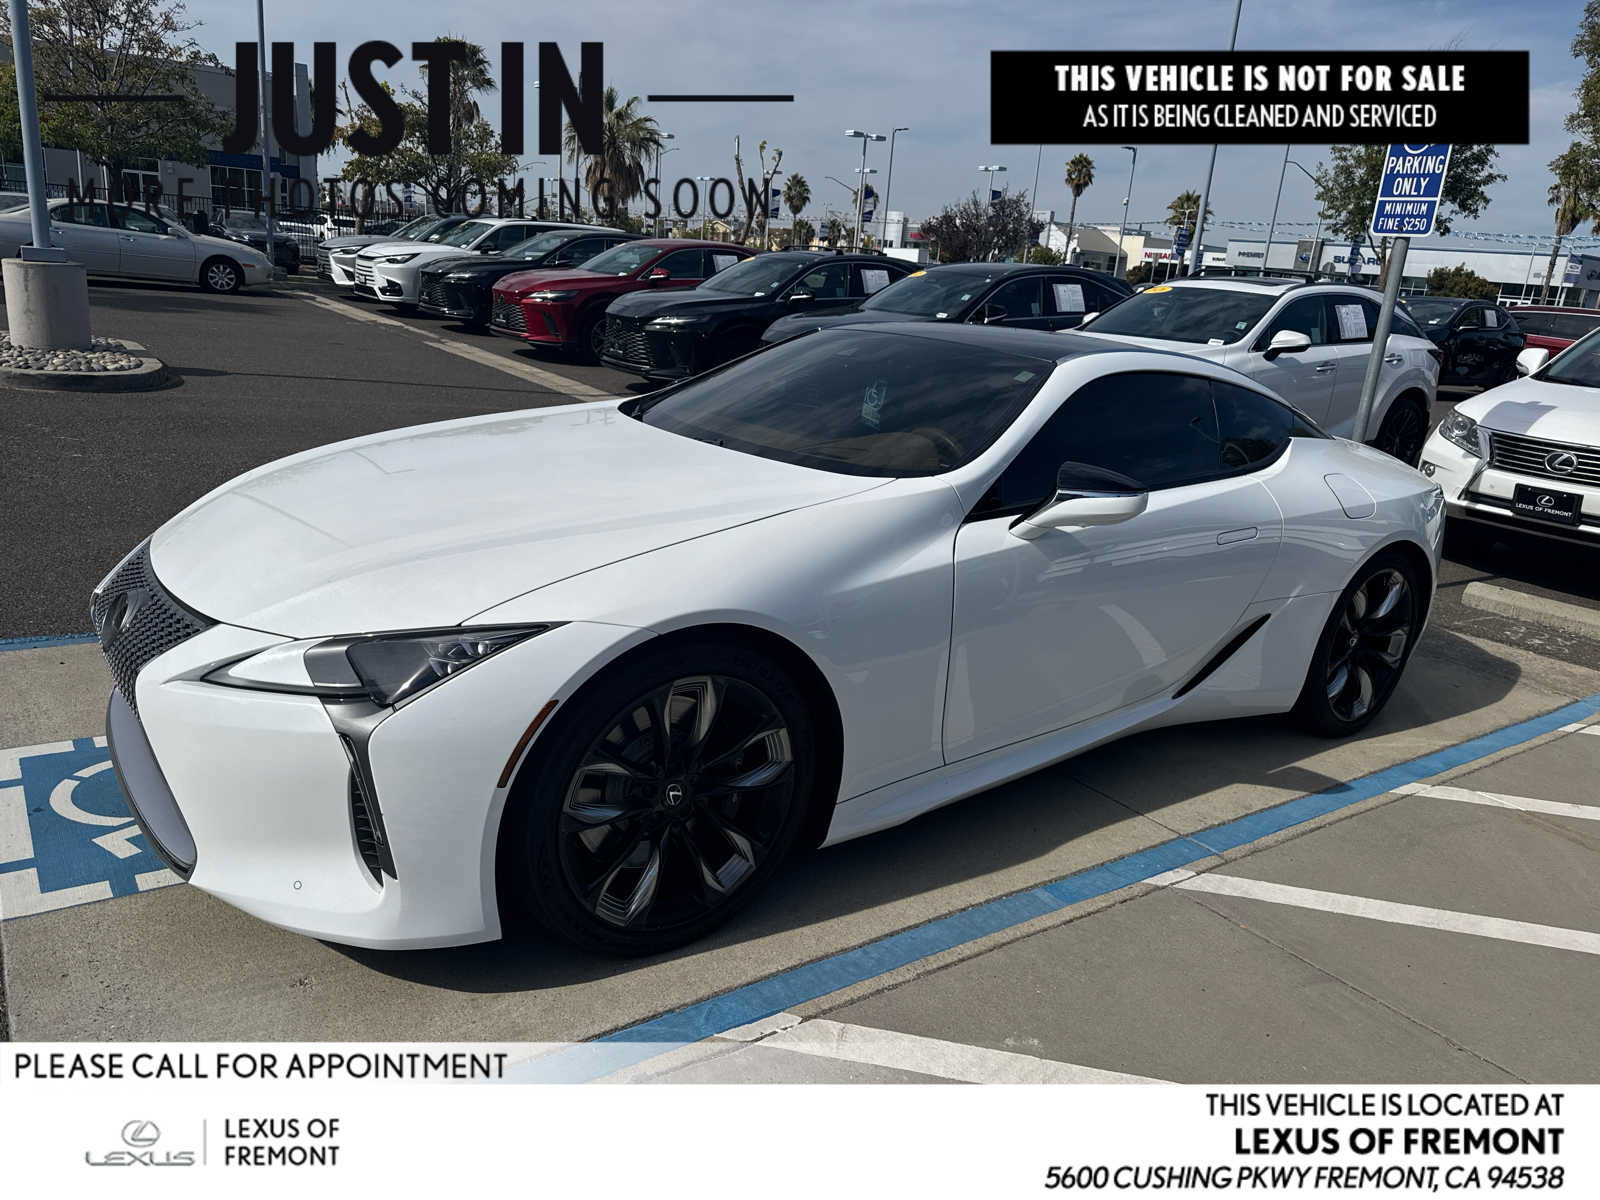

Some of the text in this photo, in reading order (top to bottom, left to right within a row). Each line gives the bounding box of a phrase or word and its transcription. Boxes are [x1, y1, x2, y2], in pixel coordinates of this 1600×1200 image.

[1386, 155, 1445, 175] PARKING
[1392, 177, 1429, 196] ONLY
[1383, 202, 1428, 215] MINIMUM
[1377, 217, 1427, 231] FINE $250
[1515, 502, 1534, 511] LEXUS
[1544, 507, 1573, 518] FREMONT
